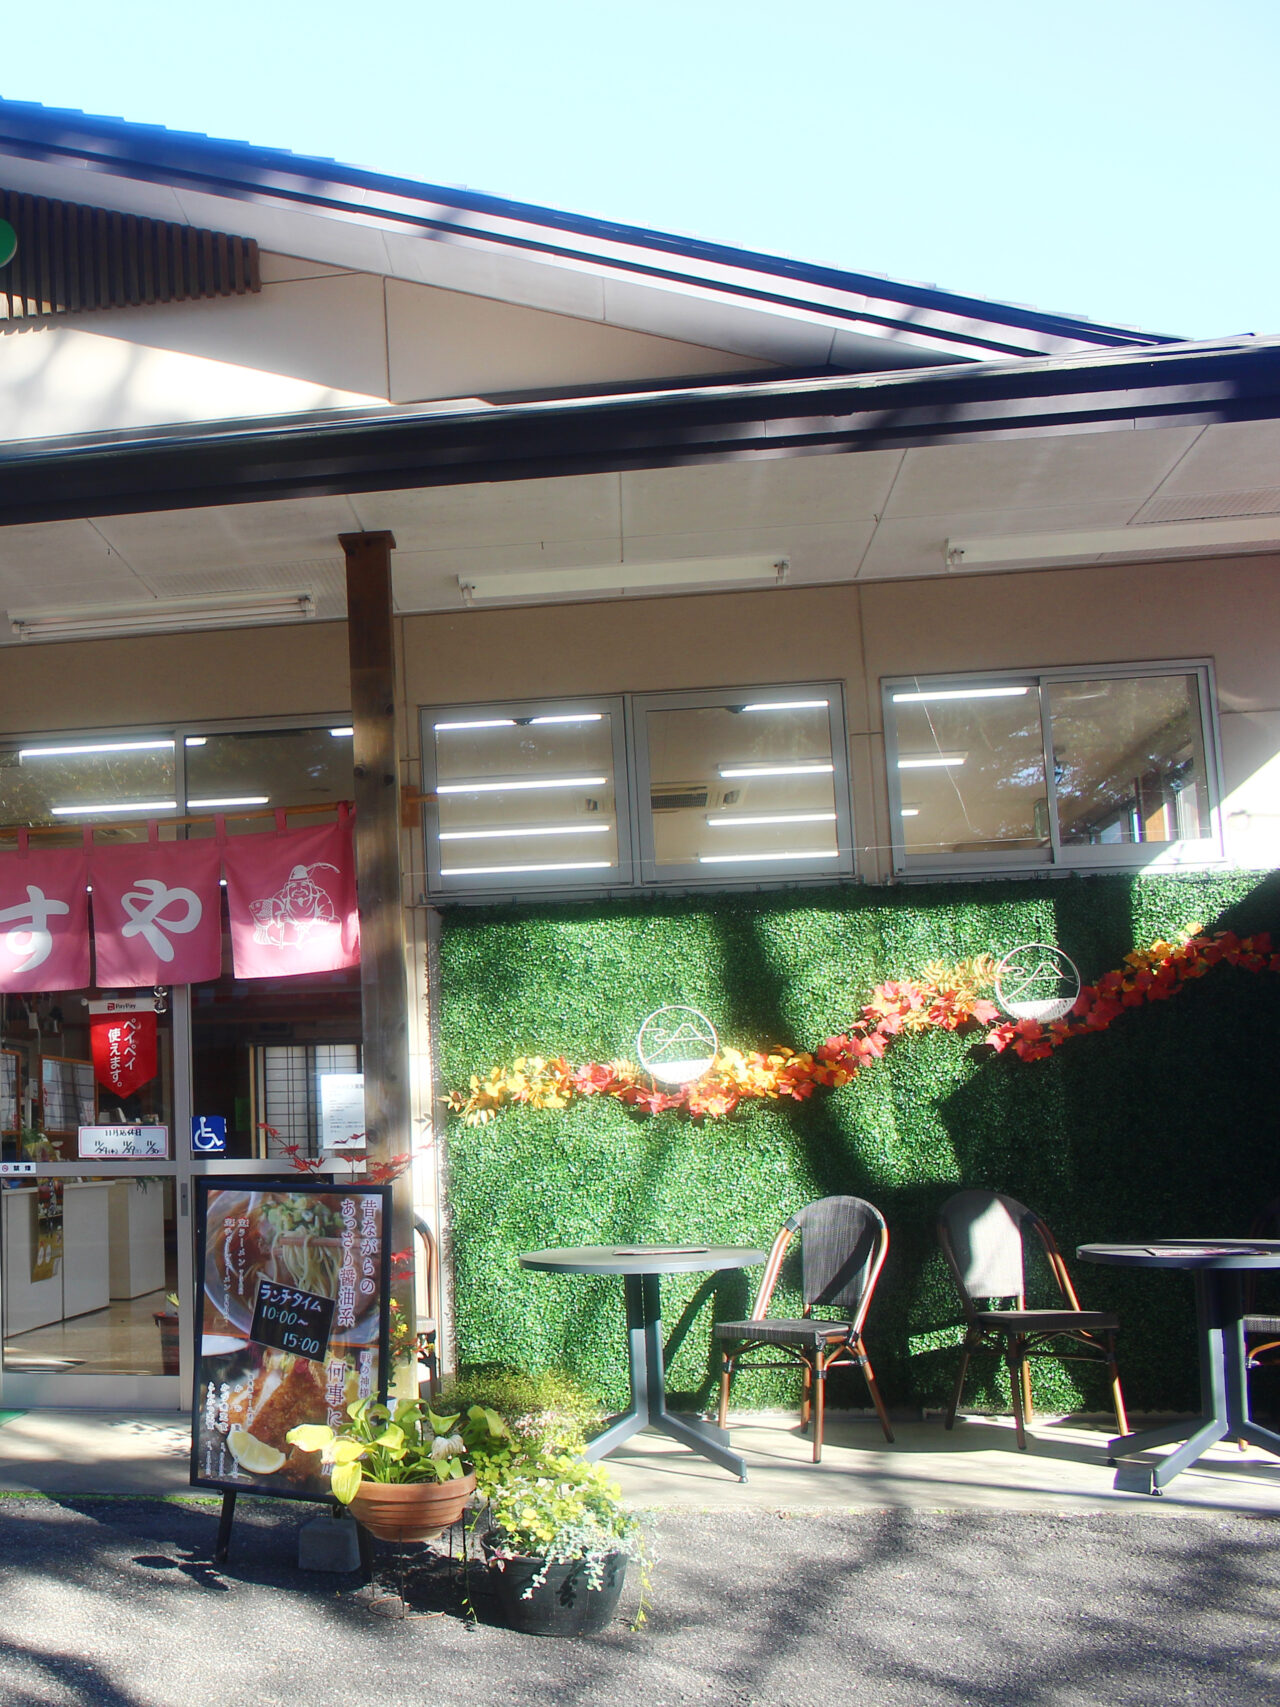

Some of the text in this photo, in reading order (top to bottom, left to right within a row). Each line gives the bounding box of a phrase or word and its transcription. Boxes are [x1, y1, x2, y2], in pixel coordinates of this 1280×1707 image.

[108, 1027, 122, 1087] 使えます。
[123, 1018, 137, 1071] ペイペイ
[338, 1199, 357, 1328] あっさり醤油系
[360, 1199, 378, 1294] 昔ながらの
[260, 1284, 322, 1312] ランチタイム
[283, 1332, 320, 1354] 15:00
